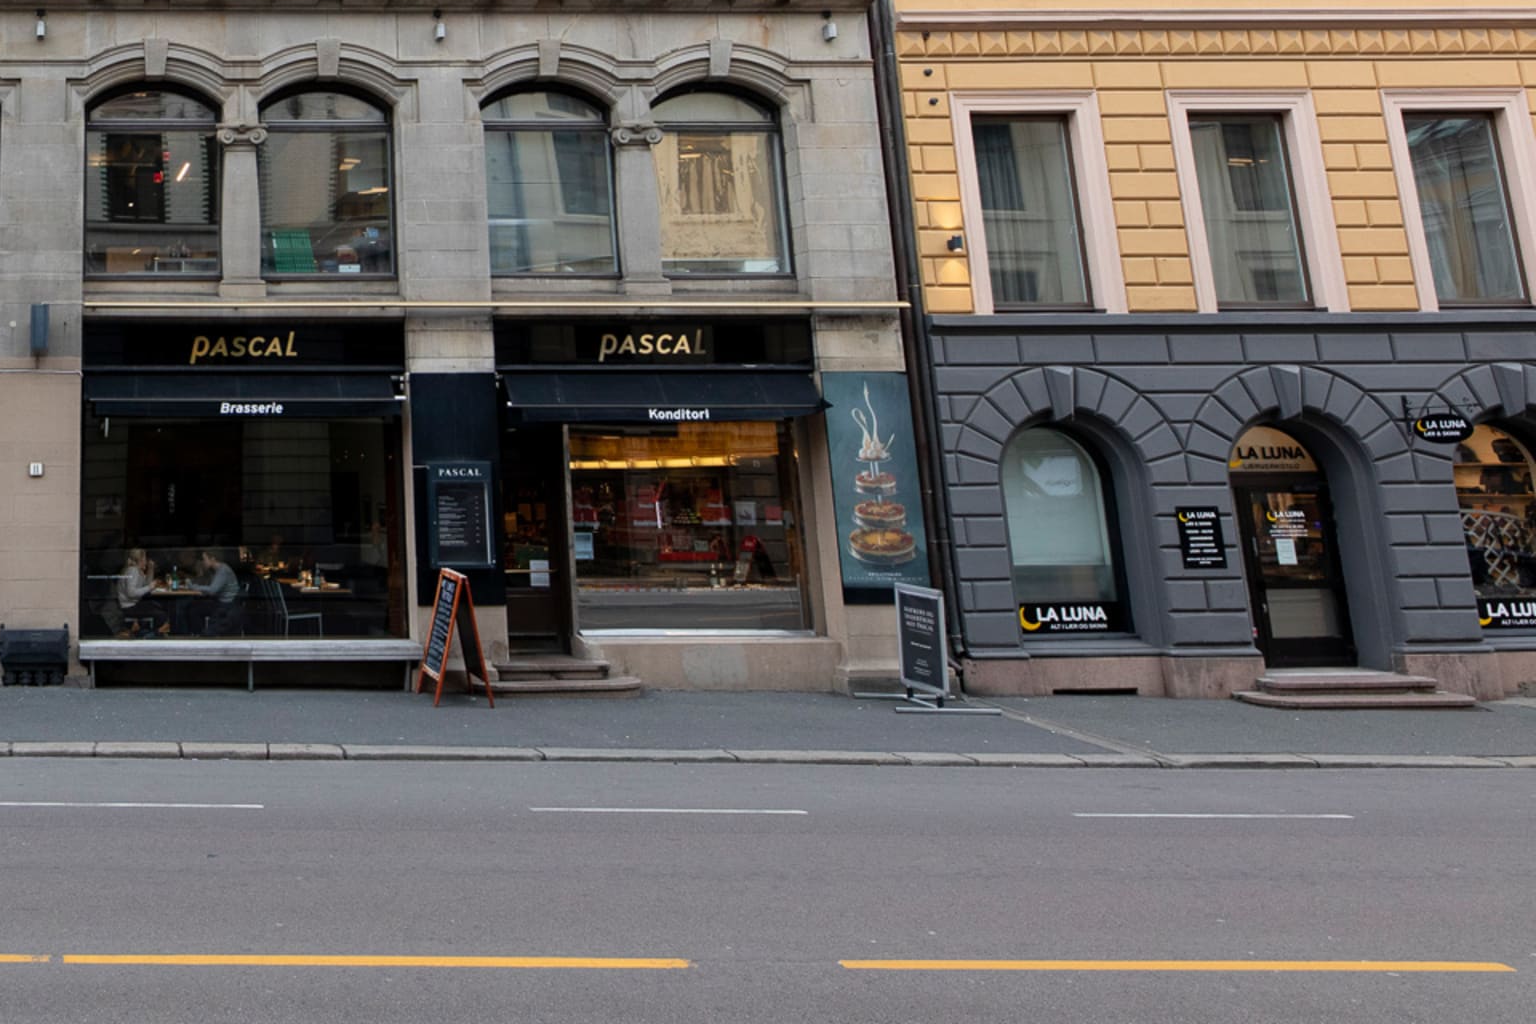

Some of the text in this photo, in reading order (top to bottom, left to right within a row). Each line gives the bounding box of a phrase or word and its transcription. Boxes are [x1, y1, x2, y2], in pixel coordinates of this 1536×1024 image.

[189, 331, 299, 365] PASCAL
[598, 329, 706, 363] PASCAL
[220, 401, 284, 414] Brasserie
[648, 408, 710, 420] Konditori
[1426, 419, 1467, 429] LA LUNA
[1237, 446, 1306, 459] LA LUNA
[438, 468, 482, 477] PASCAL
[1036, 606, 1108, 621] LA LUNA
[1486, 602, 1536, 617] LA LU
